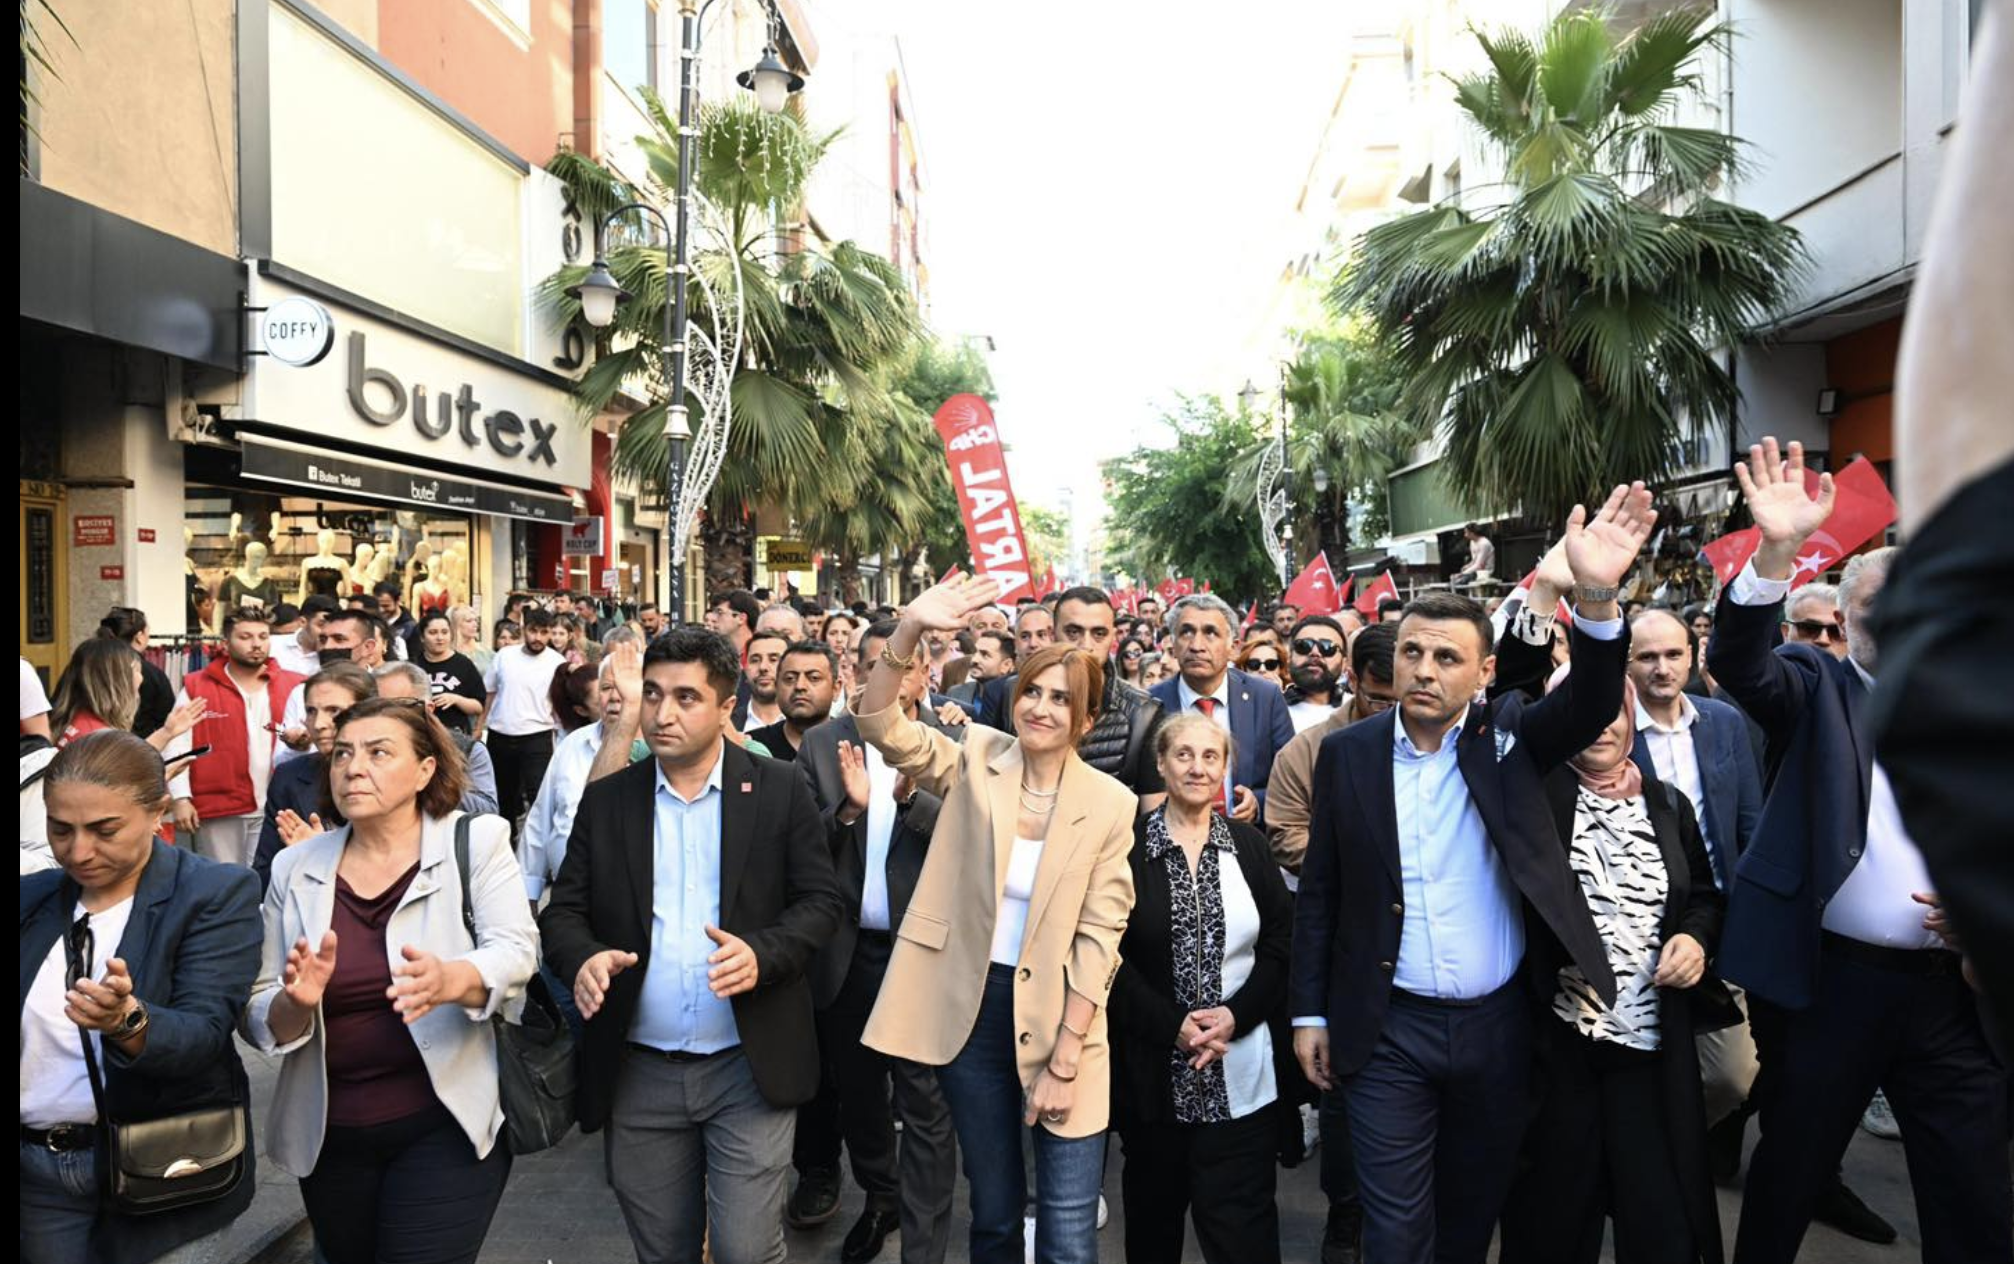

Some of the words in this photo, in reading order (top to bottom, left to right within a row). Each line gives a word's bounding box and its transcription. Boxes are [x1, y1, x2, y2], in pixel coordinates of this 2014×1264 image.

[269, 321, 317, 340] COFFY
[346, 330, 557, 467] butex
[411, 481, 437, 501] butex
